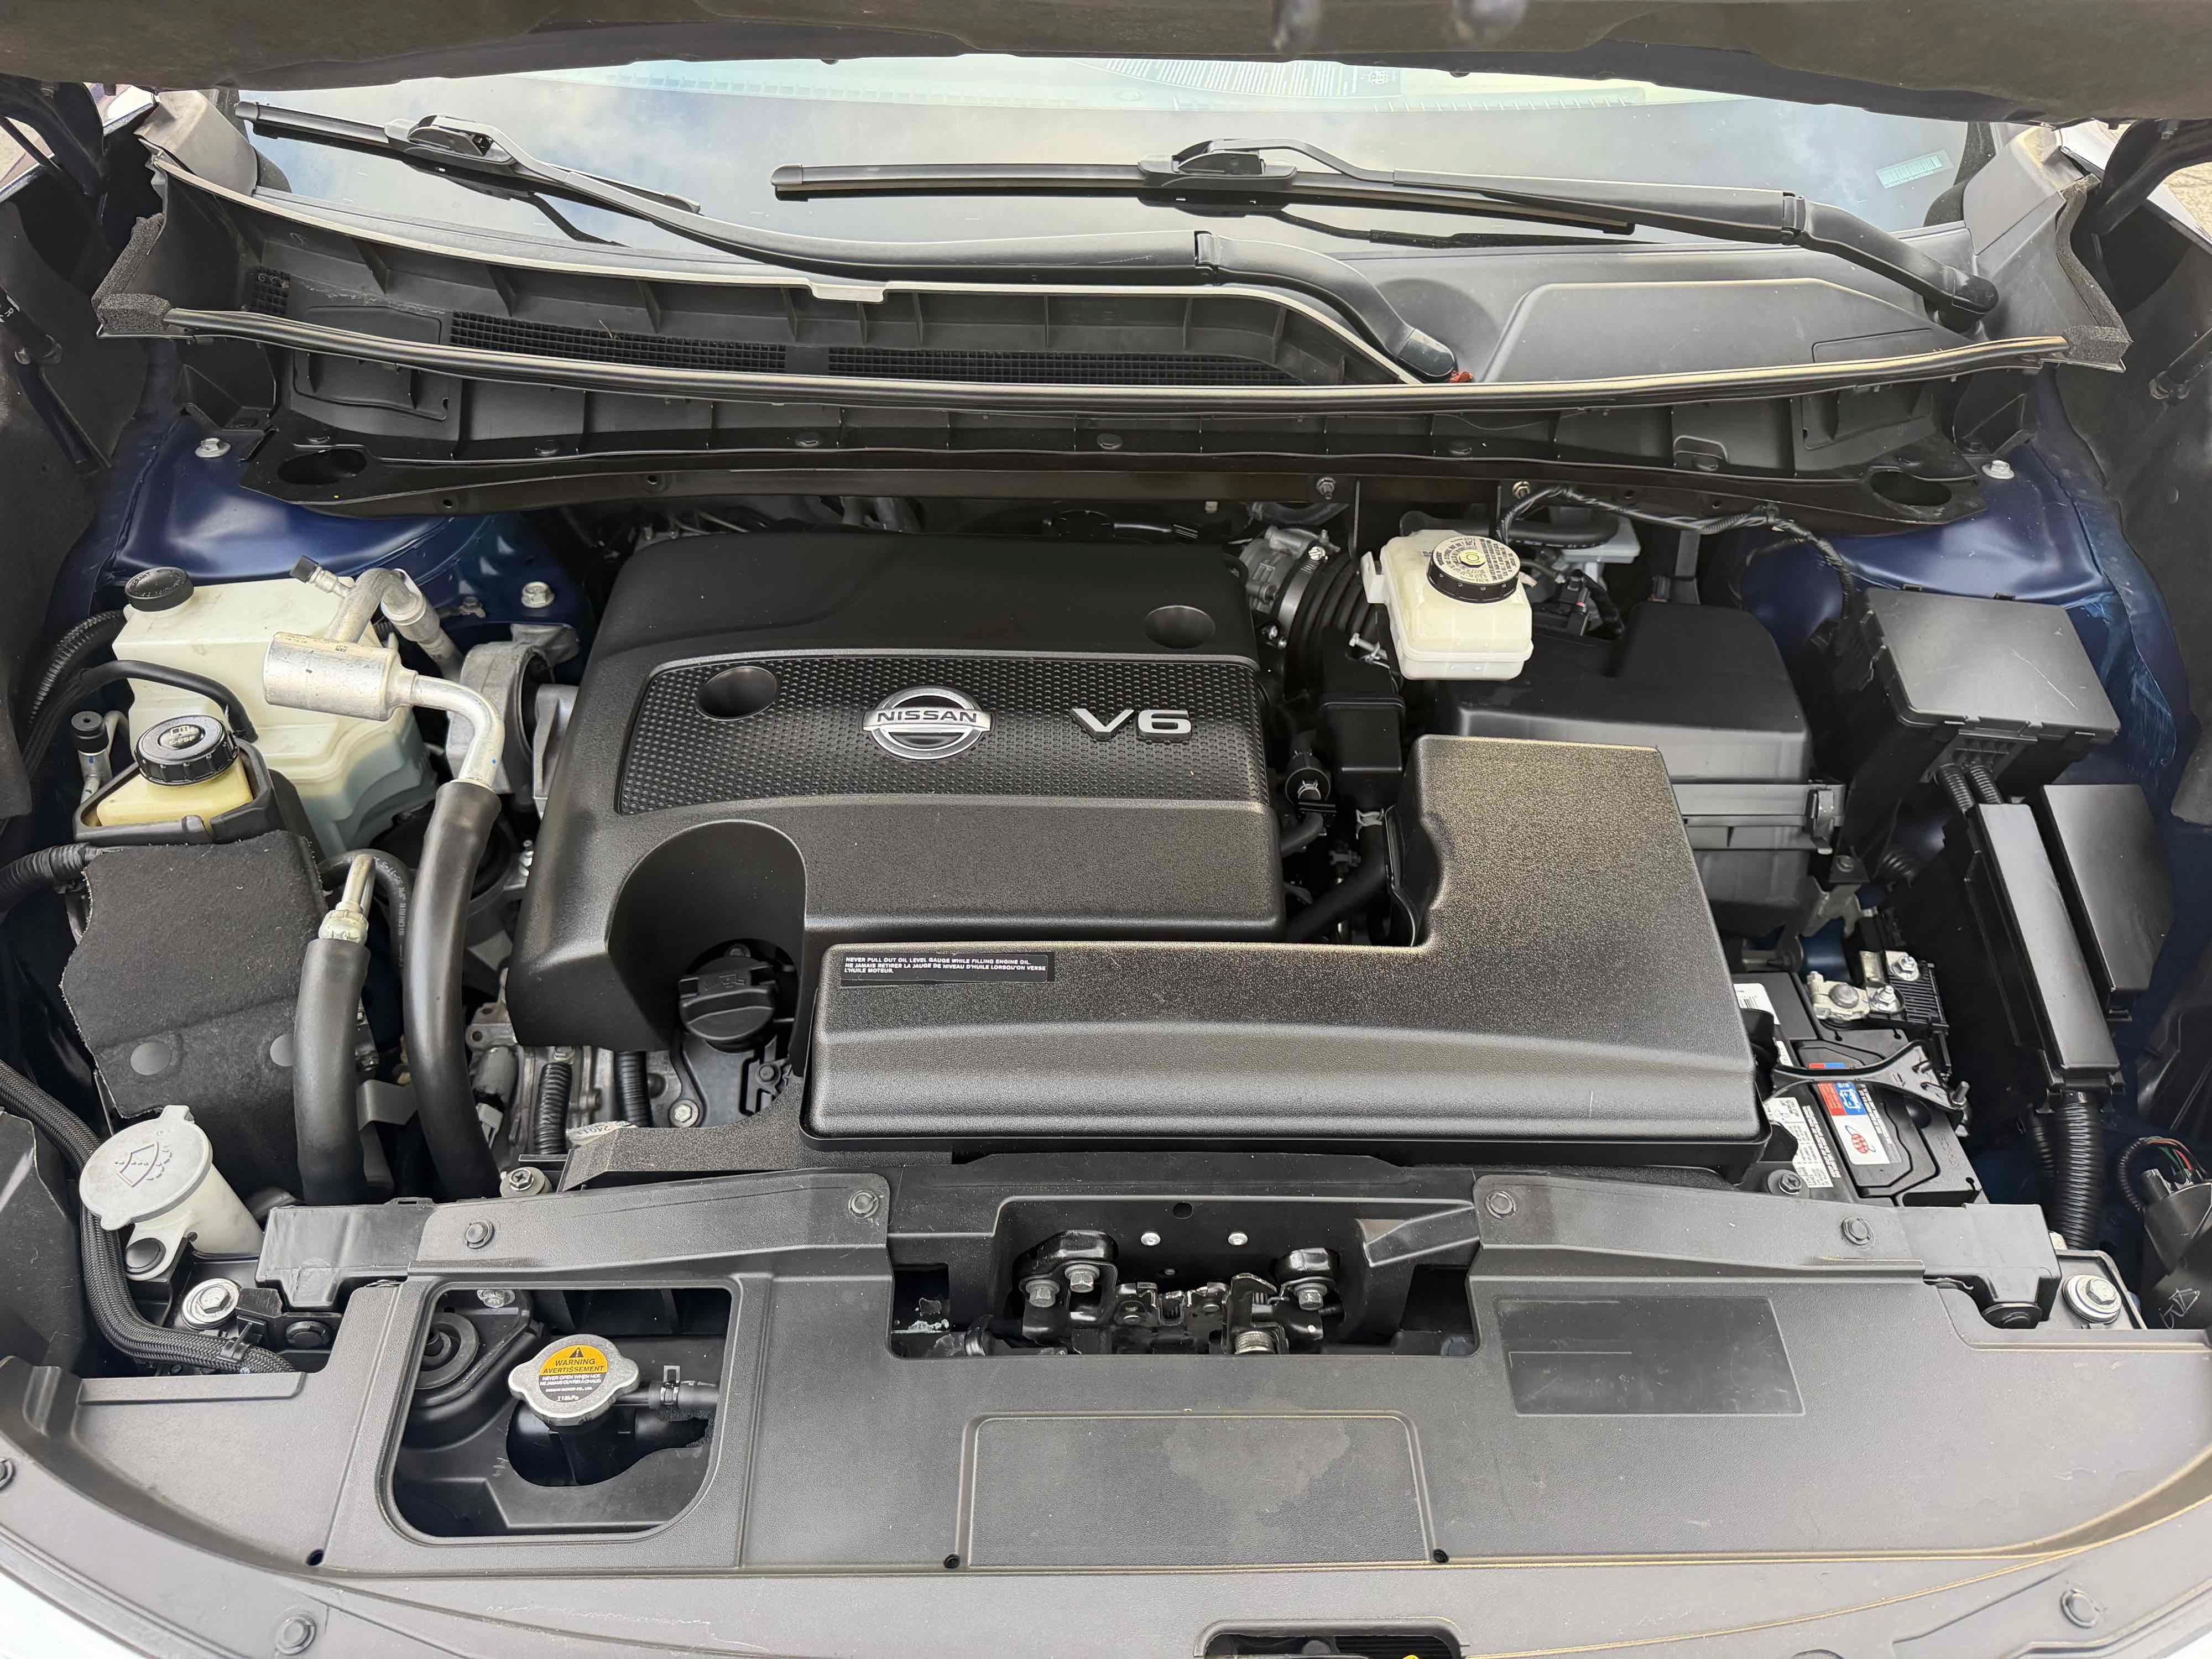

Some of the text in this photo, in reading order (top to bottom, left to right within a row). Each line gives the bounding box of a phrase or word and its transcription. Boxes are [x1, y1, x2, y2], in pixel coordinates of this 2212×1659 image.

[877, 710, 977, 723] NISSAN
[1071, 708, 1192, 738] V6
[555, 1358, 596, 1366] WARNING
[543, 1365, 605, 1374] AVERTISSEMENT
